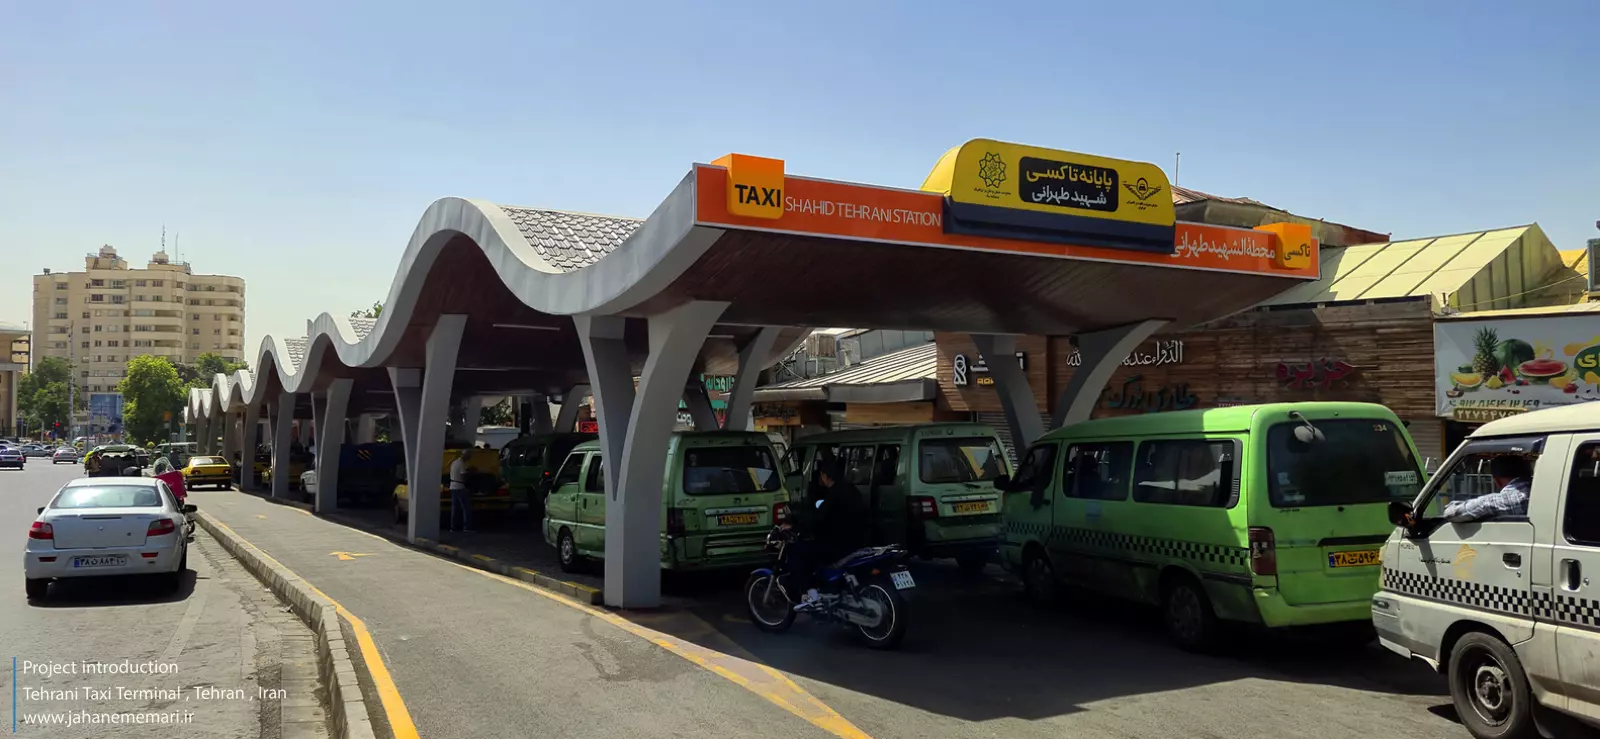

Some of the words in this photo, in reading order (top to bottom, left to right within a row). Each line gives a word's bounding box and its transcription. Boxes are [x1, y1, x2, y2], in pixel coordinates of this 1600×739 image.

[1026, 164, 1079, 183] تاکسی
[1079, 169, 1113, 192] پایانه
[734, 183, 782, 208] TAXI
[1031, 184, 1070, 204] طهرانی
[1070, 191, 1107, 208] شهید
[785, 195, 835, 216] SHAHID
[836, 202, 892, 223] TEHRANI
[893, 209, 942, 228] STATION
[1283, 242, 1311, 261] تاکسی
